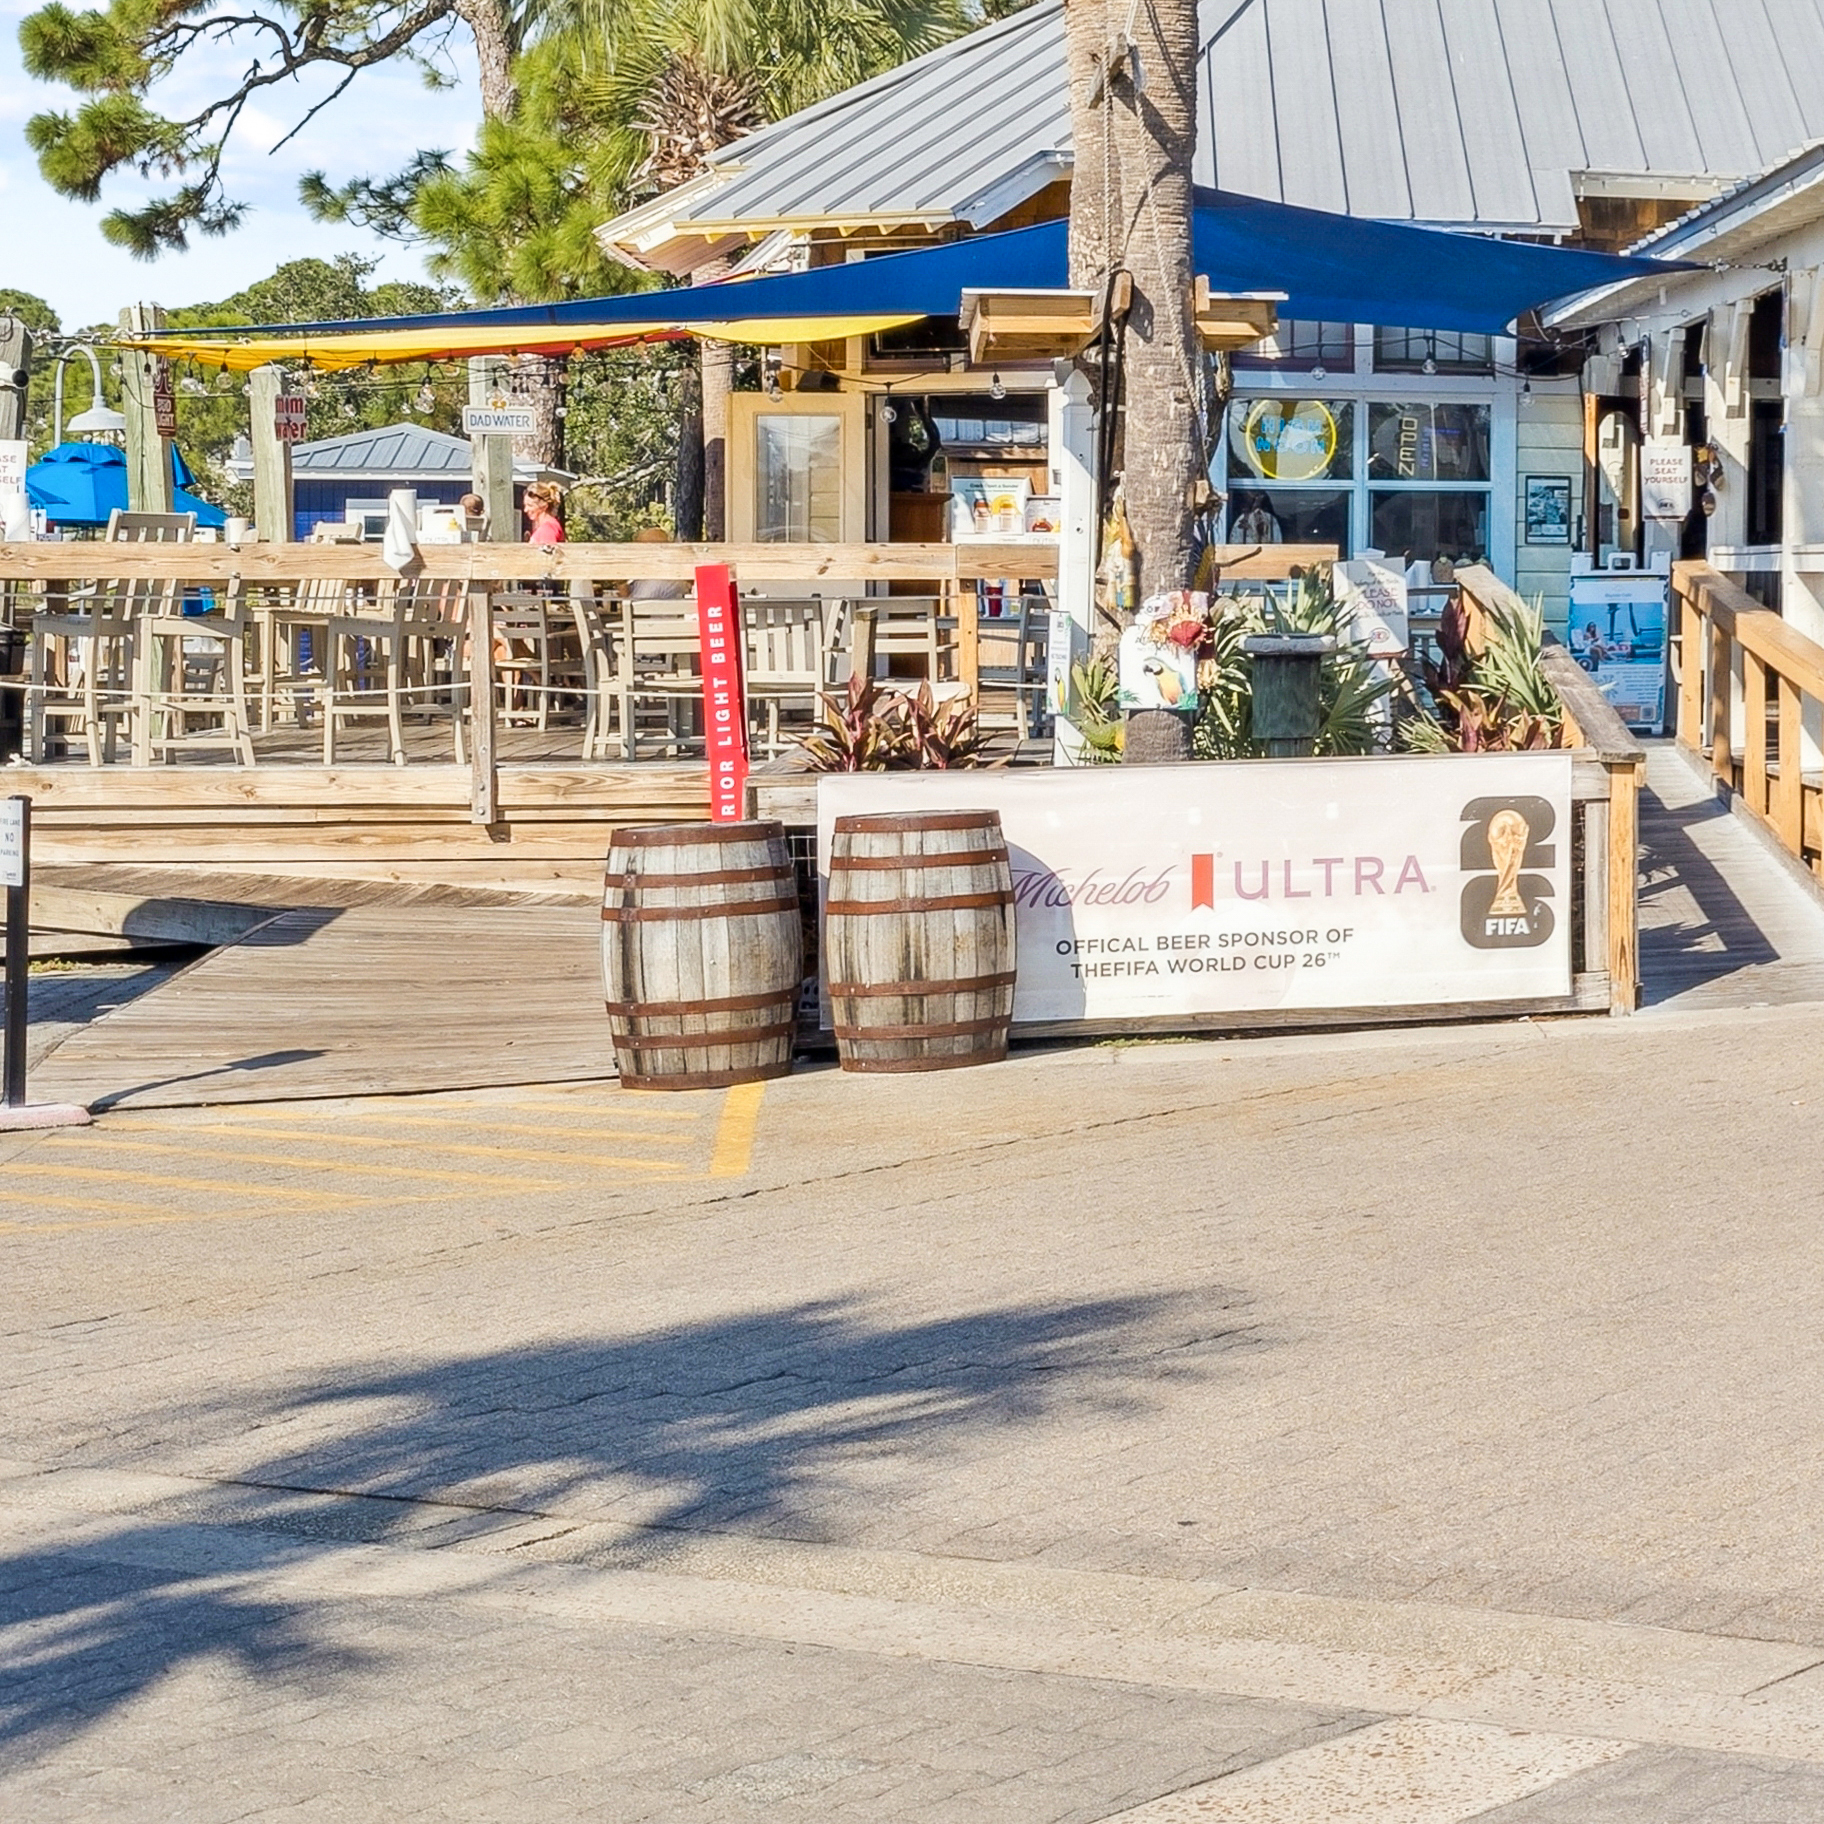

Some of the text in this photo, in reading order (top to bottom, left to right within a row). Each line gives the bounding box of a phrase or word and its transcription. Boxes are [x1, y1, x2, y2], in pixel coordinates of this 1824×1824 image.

[470, 414, 530, 428] DAD WATER
[1399, 417, 1418, 476] OPEN
[1650, 458, 1683, 466] PLEASE
[1655, 467, 1678, 475] SEAT
[1644, 477, 1688, 485] YOURSELF
[708, 606, 726, 663] BEER
[713, 677, 733, 746] LIGHT
[5, 832, 14, 842] NO
[1013, 854, 1430, 909] Michelob ULTRA
[1485, 917, 1531, 936] FIFA
[1055, 928, 1354, 956] OFFICAL BEER SPONSOR OF
[1071, 959, 1160, 979] THEFIFA
[1167, 955, 1246, 974] WORLD
[1254, 954, 1295, 970] CUP
